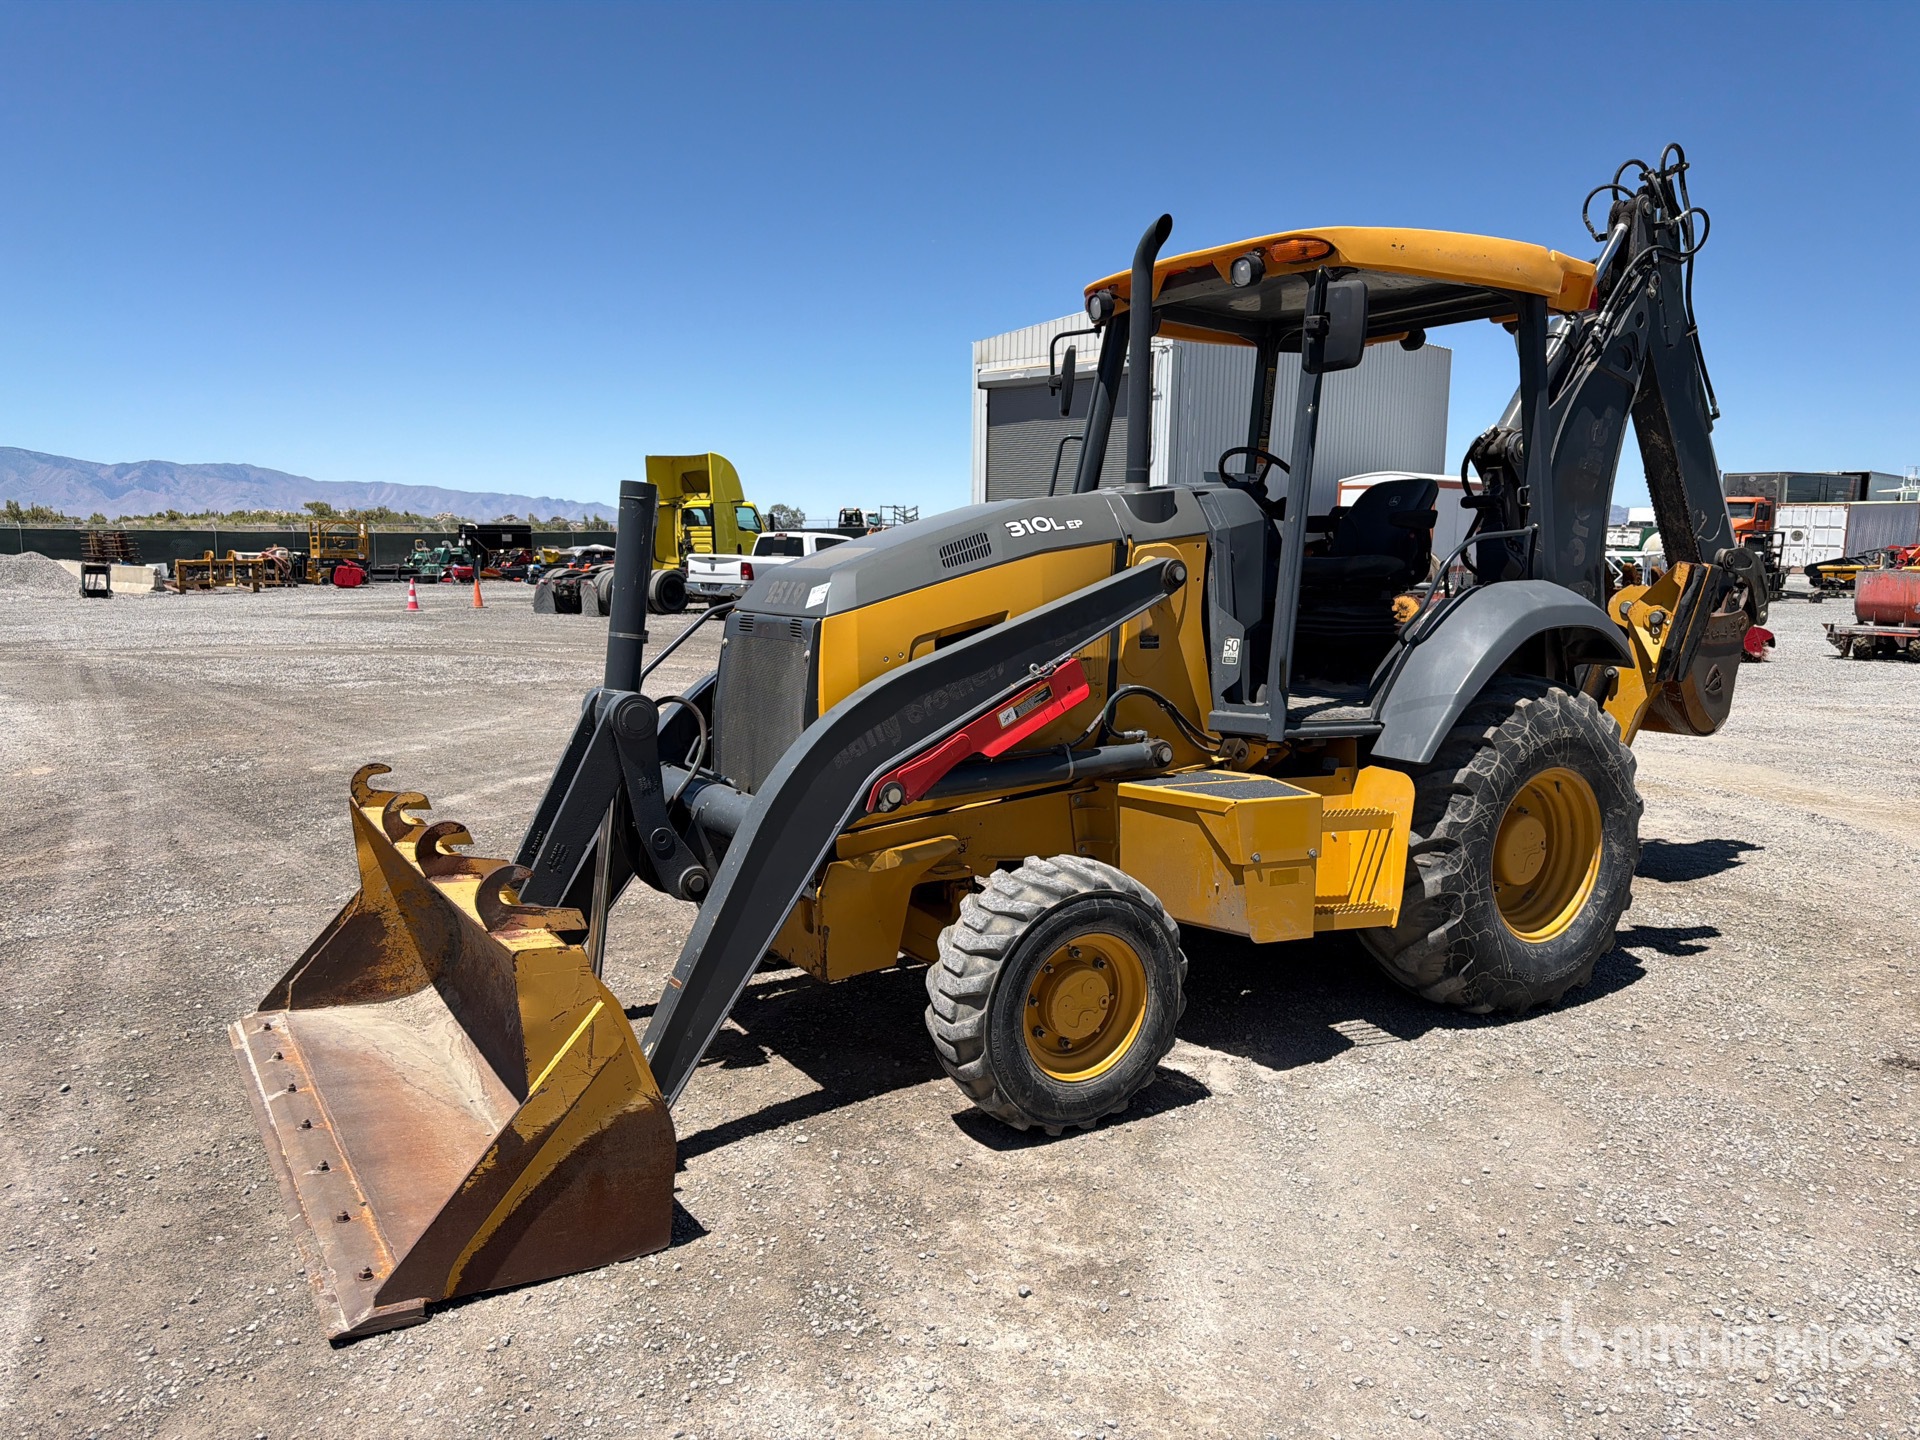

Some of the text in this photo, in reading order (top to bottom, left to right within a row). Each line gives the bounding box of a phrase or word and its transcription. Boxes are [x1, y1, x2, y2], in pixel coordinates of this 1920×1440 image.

[1004, 516, 1083, 538] 310L EP
[1224, 639, 1239, 652] 50
